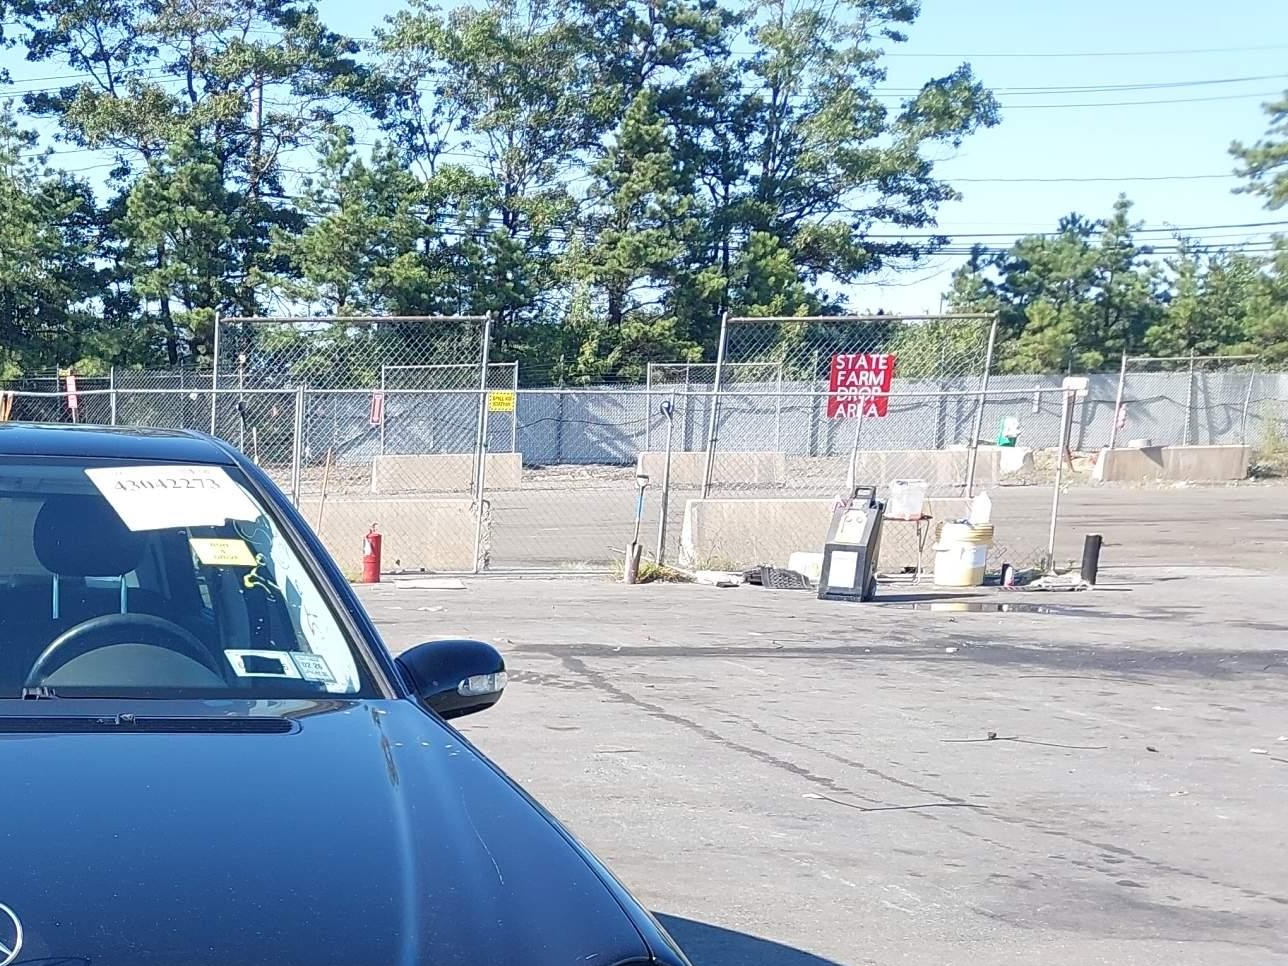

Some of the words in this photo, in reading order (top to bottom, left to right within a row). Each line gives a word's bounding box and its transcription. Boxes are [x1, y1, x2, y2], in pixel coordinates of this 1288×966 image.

[836, 354, 889, 369] STATE
[837, 370, 884, 386] FARM
[836, 386, 882, 401] DROP
[834, 403, 879, 418] ARA
[114, 478, 221, 491] 43042273
